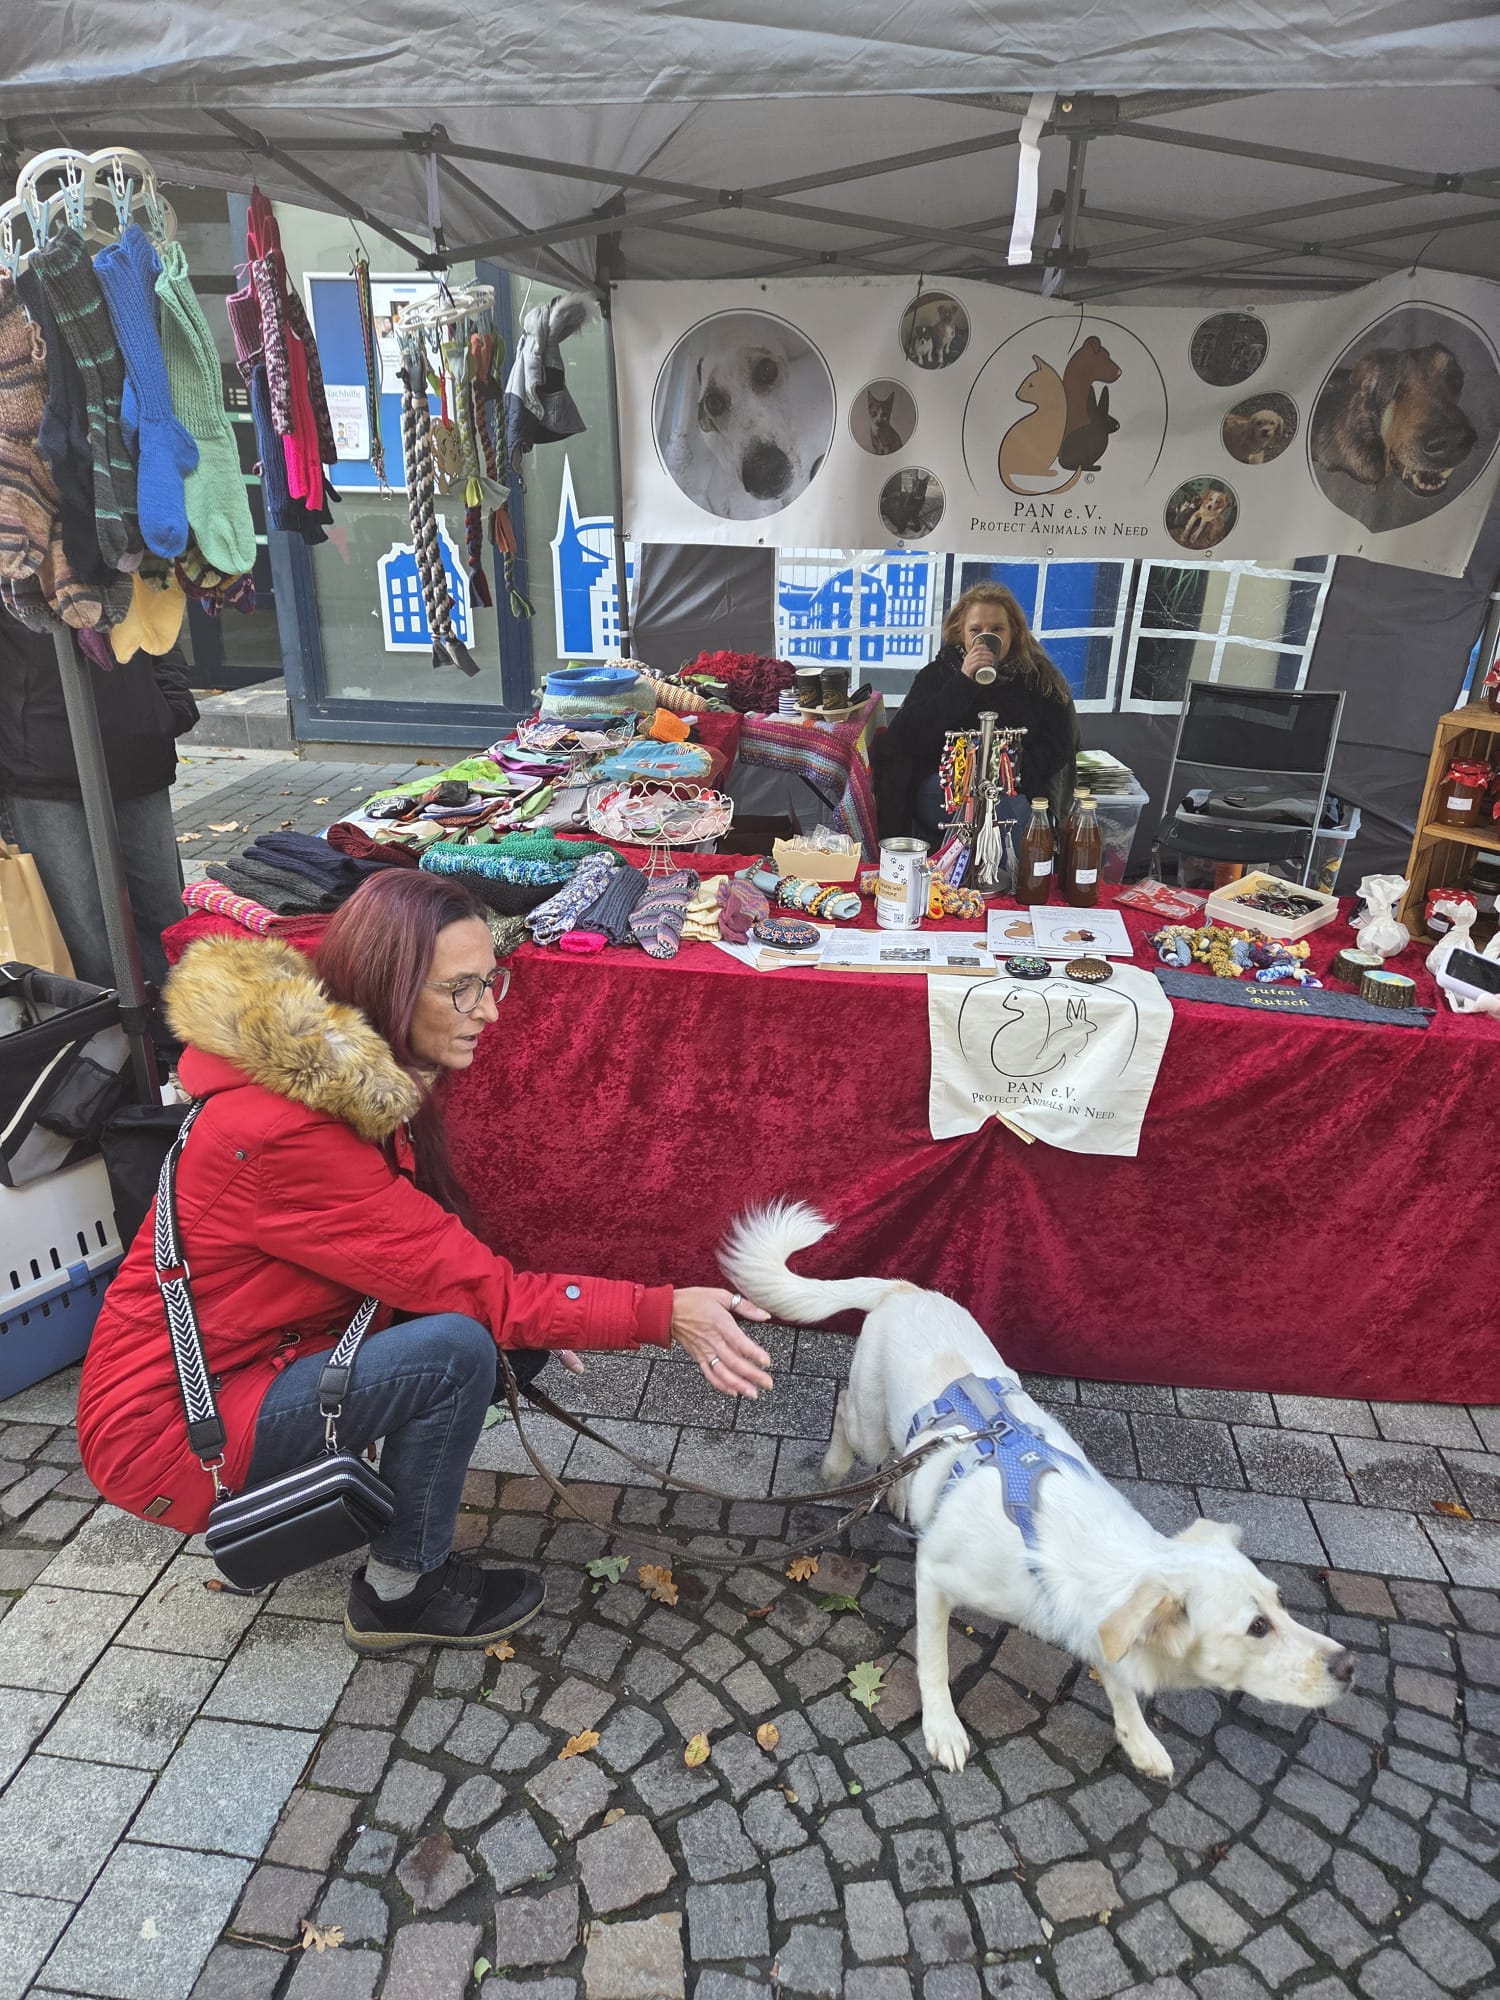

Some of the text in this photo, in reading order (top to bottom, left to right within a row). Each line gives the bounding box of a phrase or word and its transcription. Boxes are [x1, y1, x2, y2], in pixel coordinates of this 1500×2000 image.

[1013, 501, 1102, 520] PAN e.V.
[970, 517, 1149, 537] PROTECT ANIMALS IN NEED
[1245, 986, 1296, 996] Guten
[1250, 997, 1310, 1007] Rutsch
[1007, 1081, 1077, 1102] PAN e.V.
[971, 1092, 1115, 1120] PROTECT ANIMALS IN NEED
